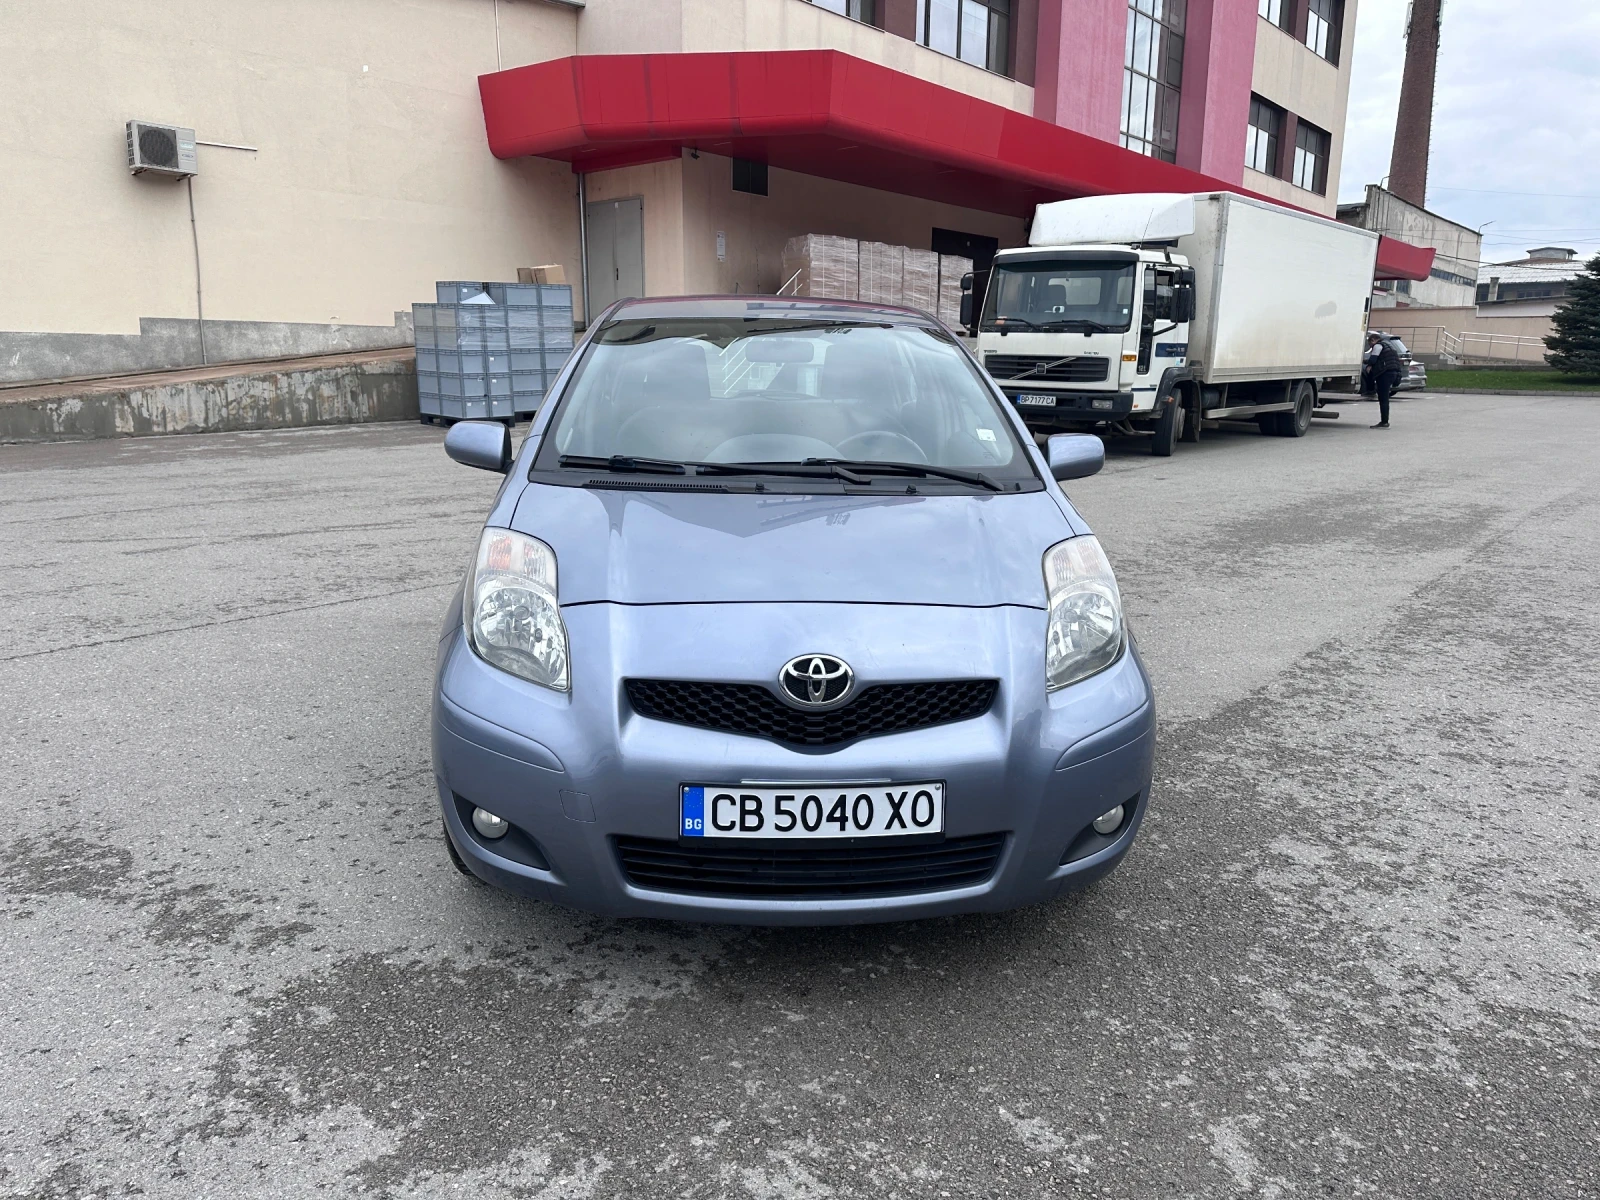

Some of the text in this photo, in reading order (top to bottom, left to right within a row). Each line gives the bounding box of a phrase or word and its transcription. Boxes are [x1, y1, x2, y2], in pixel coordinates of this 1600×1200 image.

[685, 818, 702, 830] BG
[711, 789, 935, 832] CB 5040 XO
